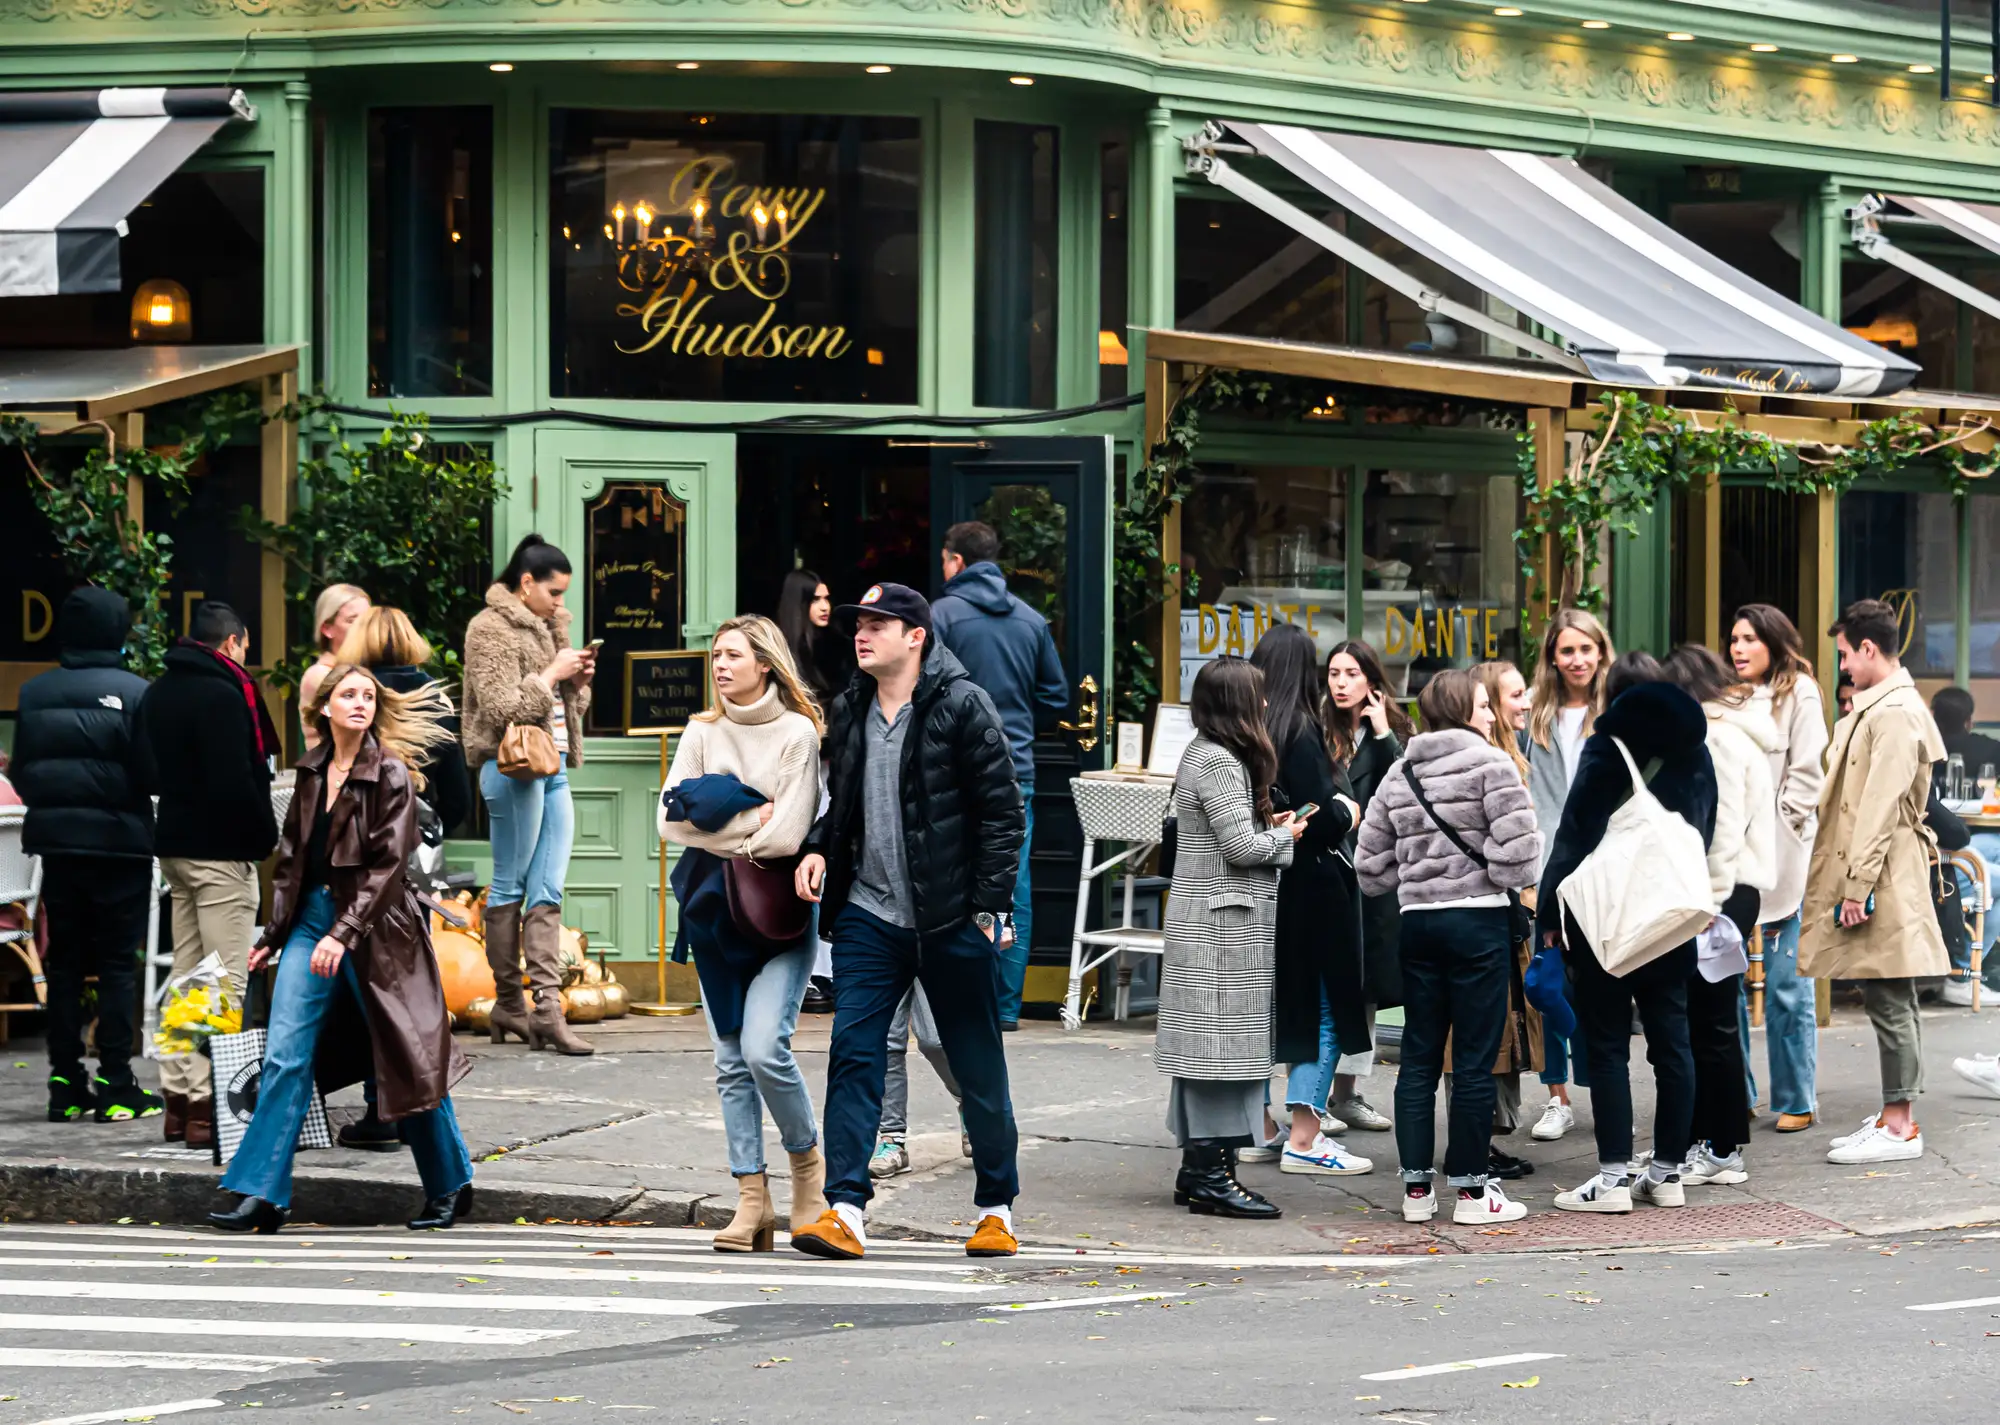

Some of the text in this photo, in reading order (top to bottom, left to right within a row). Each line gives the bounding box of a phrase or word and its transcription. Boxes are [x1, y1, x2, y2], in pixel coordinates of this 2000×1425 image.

[669, 156, 826, 253] Perry
[710, 231, 791, 300] &
[613, 294, 853, 360] Hudson
[1385, 607, 1498, 658] DANTE
